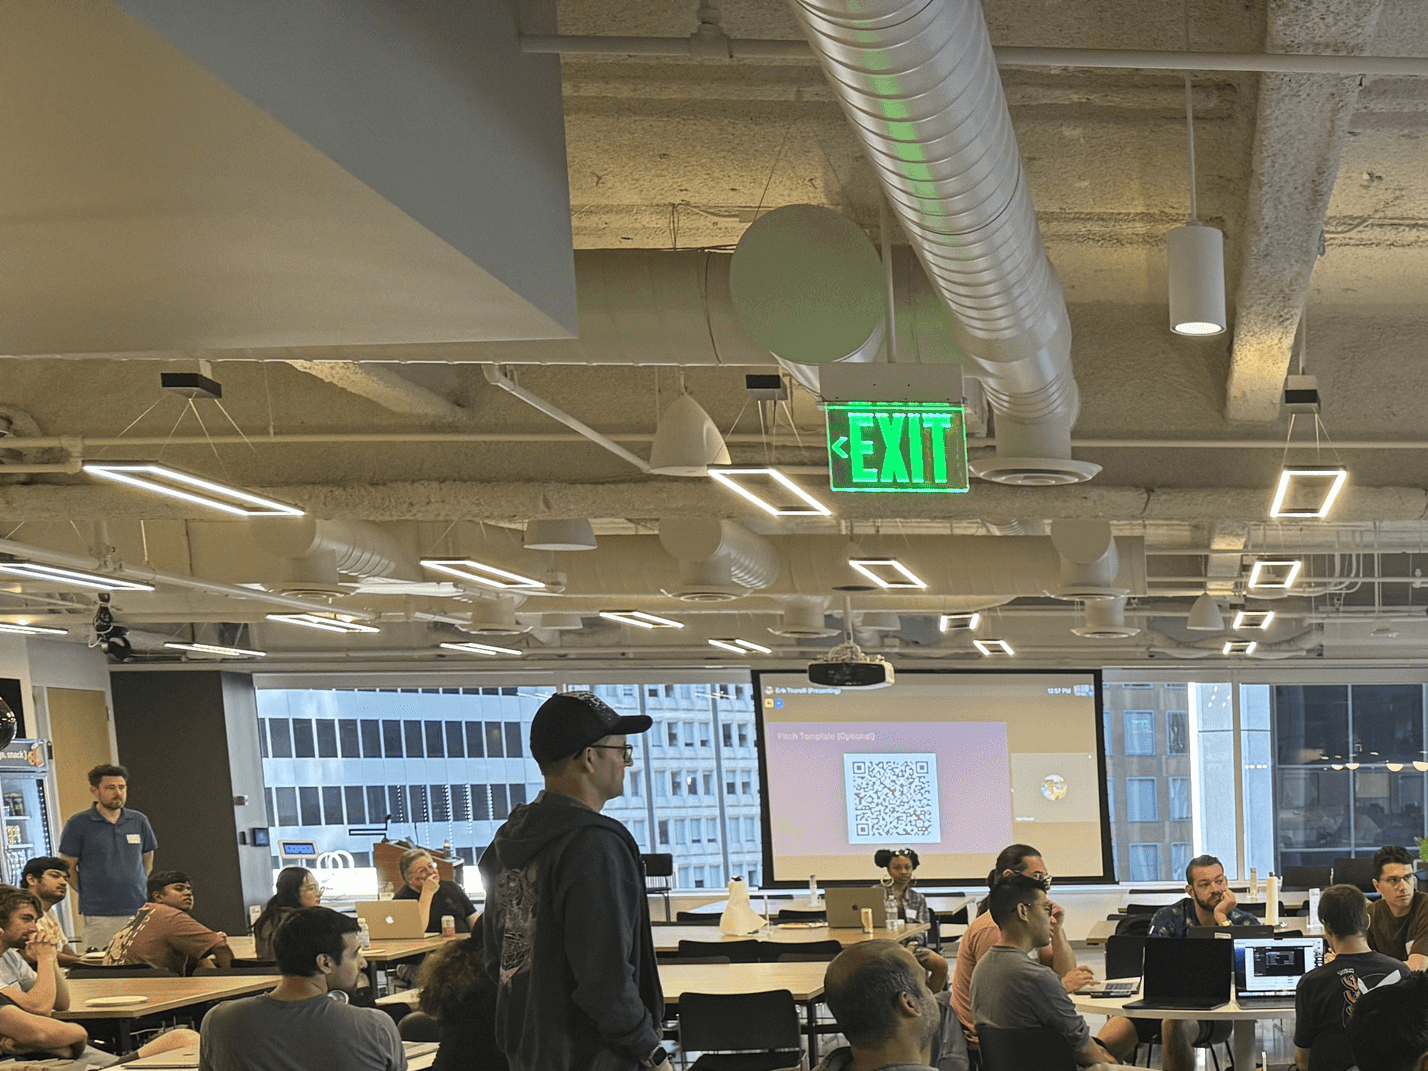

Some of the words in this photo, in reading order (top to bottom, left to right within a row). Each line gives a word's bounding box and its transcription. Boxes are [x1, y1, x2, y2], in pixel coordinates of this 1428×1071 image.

[848, 412, 953, 484] EXIT
[799, 733, 836, 742] Template
[837, 732, 876, 741] (Optional)
